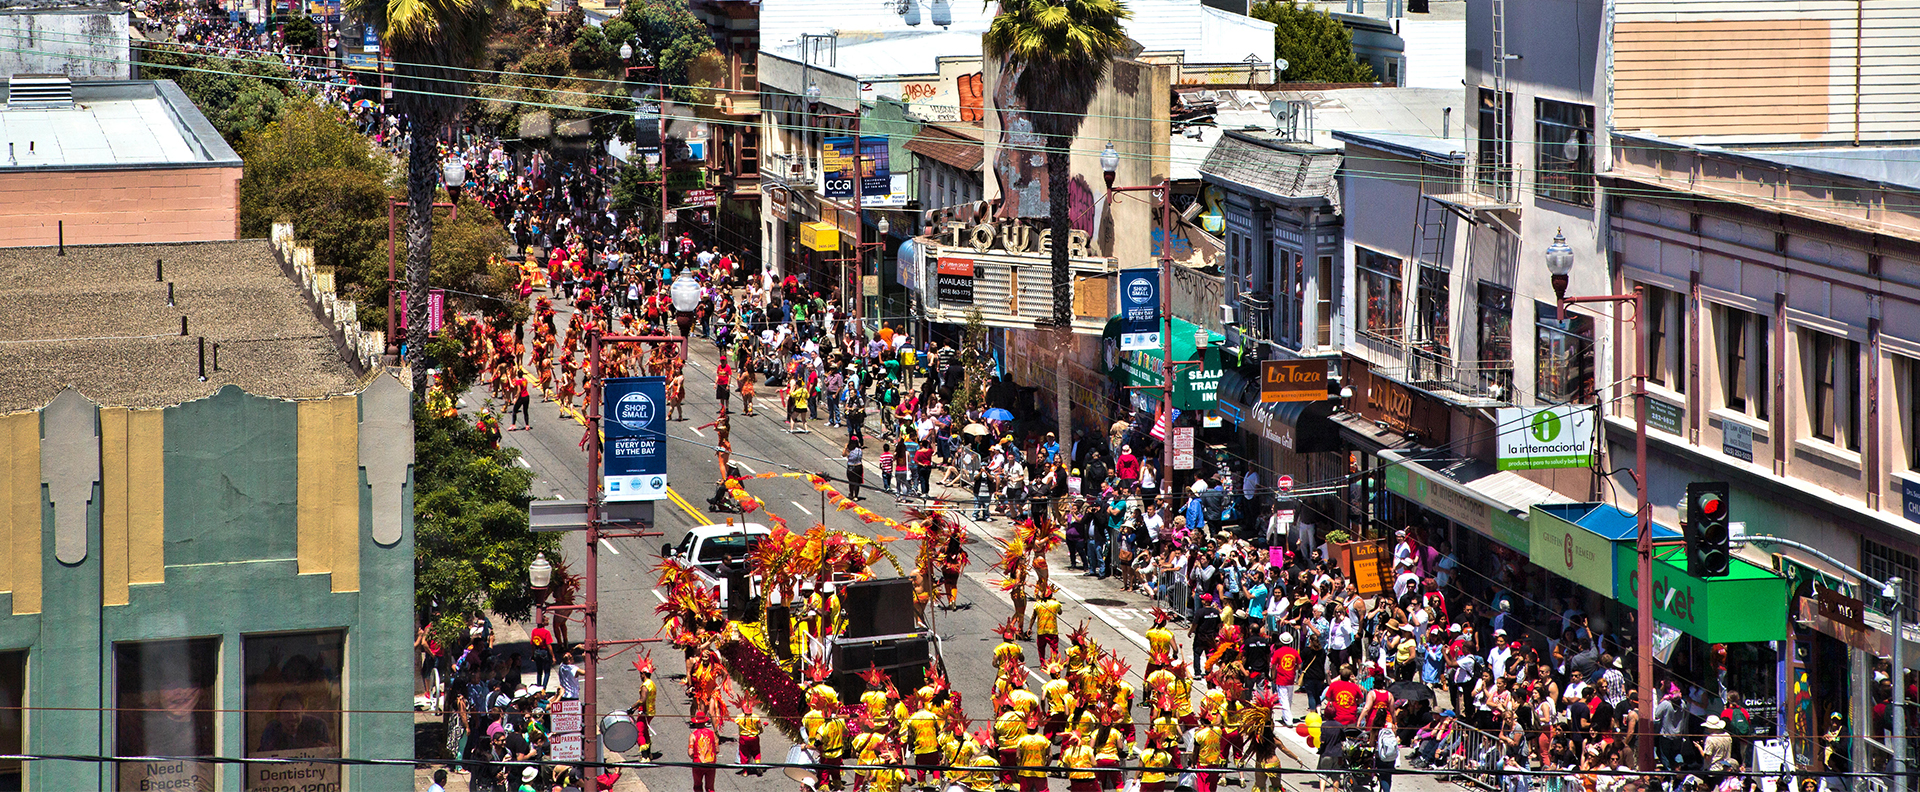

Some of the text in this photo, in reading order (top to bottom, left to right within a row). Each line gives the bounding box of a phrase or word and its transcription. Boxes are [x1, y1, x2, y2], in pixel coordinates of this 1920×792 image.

[948, 220, 1090, 259] TOWER
[939, 278, 972, 287] AVAILABLE
[1268, 365, 1320, 383] La Taza
[1508, 441, 1585, 454] la internacional
[1576, 546, 1596, 561] REMEDY
[1630, 570, 1694, 624] ccket
[552, 703, 560, 712] NO
[551, 735, 560, 743] NO
[147, 761, 183, 776] Need
[260, 768, 326, 780] Dentistry
[140, 774, 199, 791] Braces?
